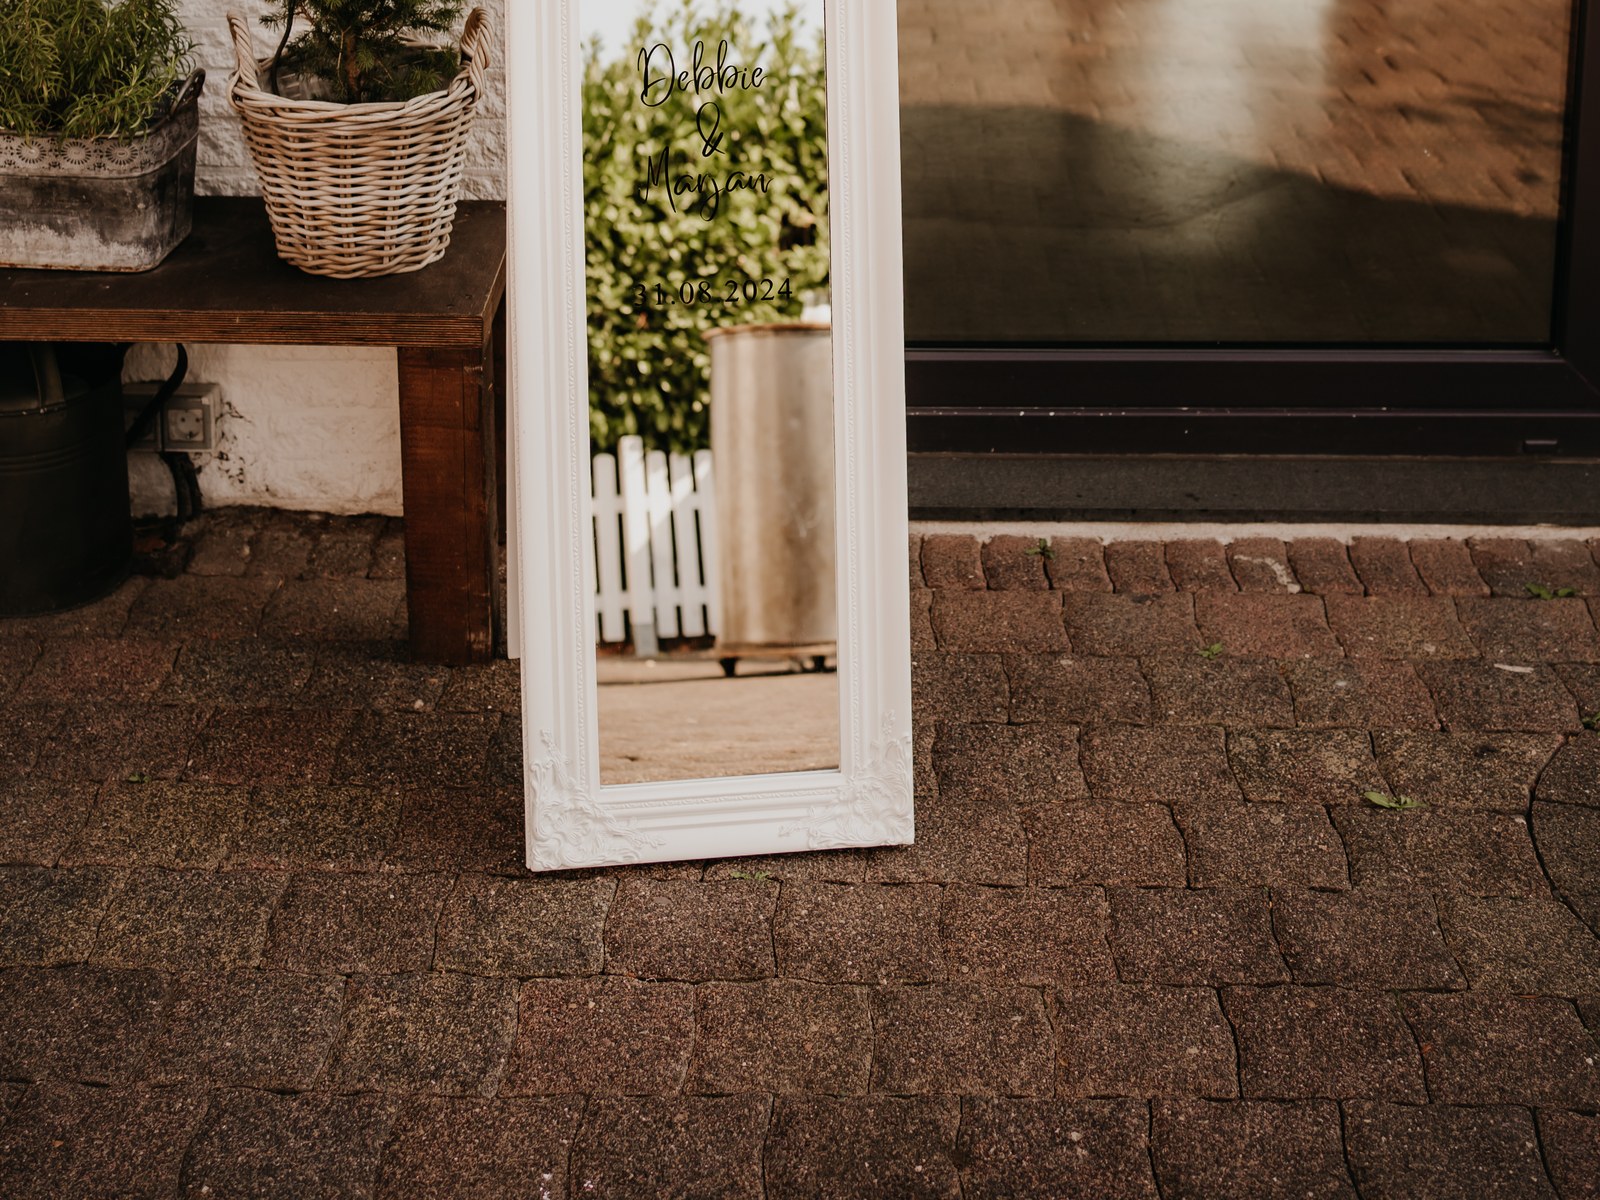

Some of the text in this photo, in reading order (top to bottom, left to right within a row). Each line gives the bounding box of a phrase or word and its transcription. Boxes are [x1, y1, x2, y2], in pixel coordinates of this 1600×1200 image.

[638, 39, 768, 107] Debbie
[696, 102, 726, 157] &
[634, 277, 793, 306] 31.08.2024
